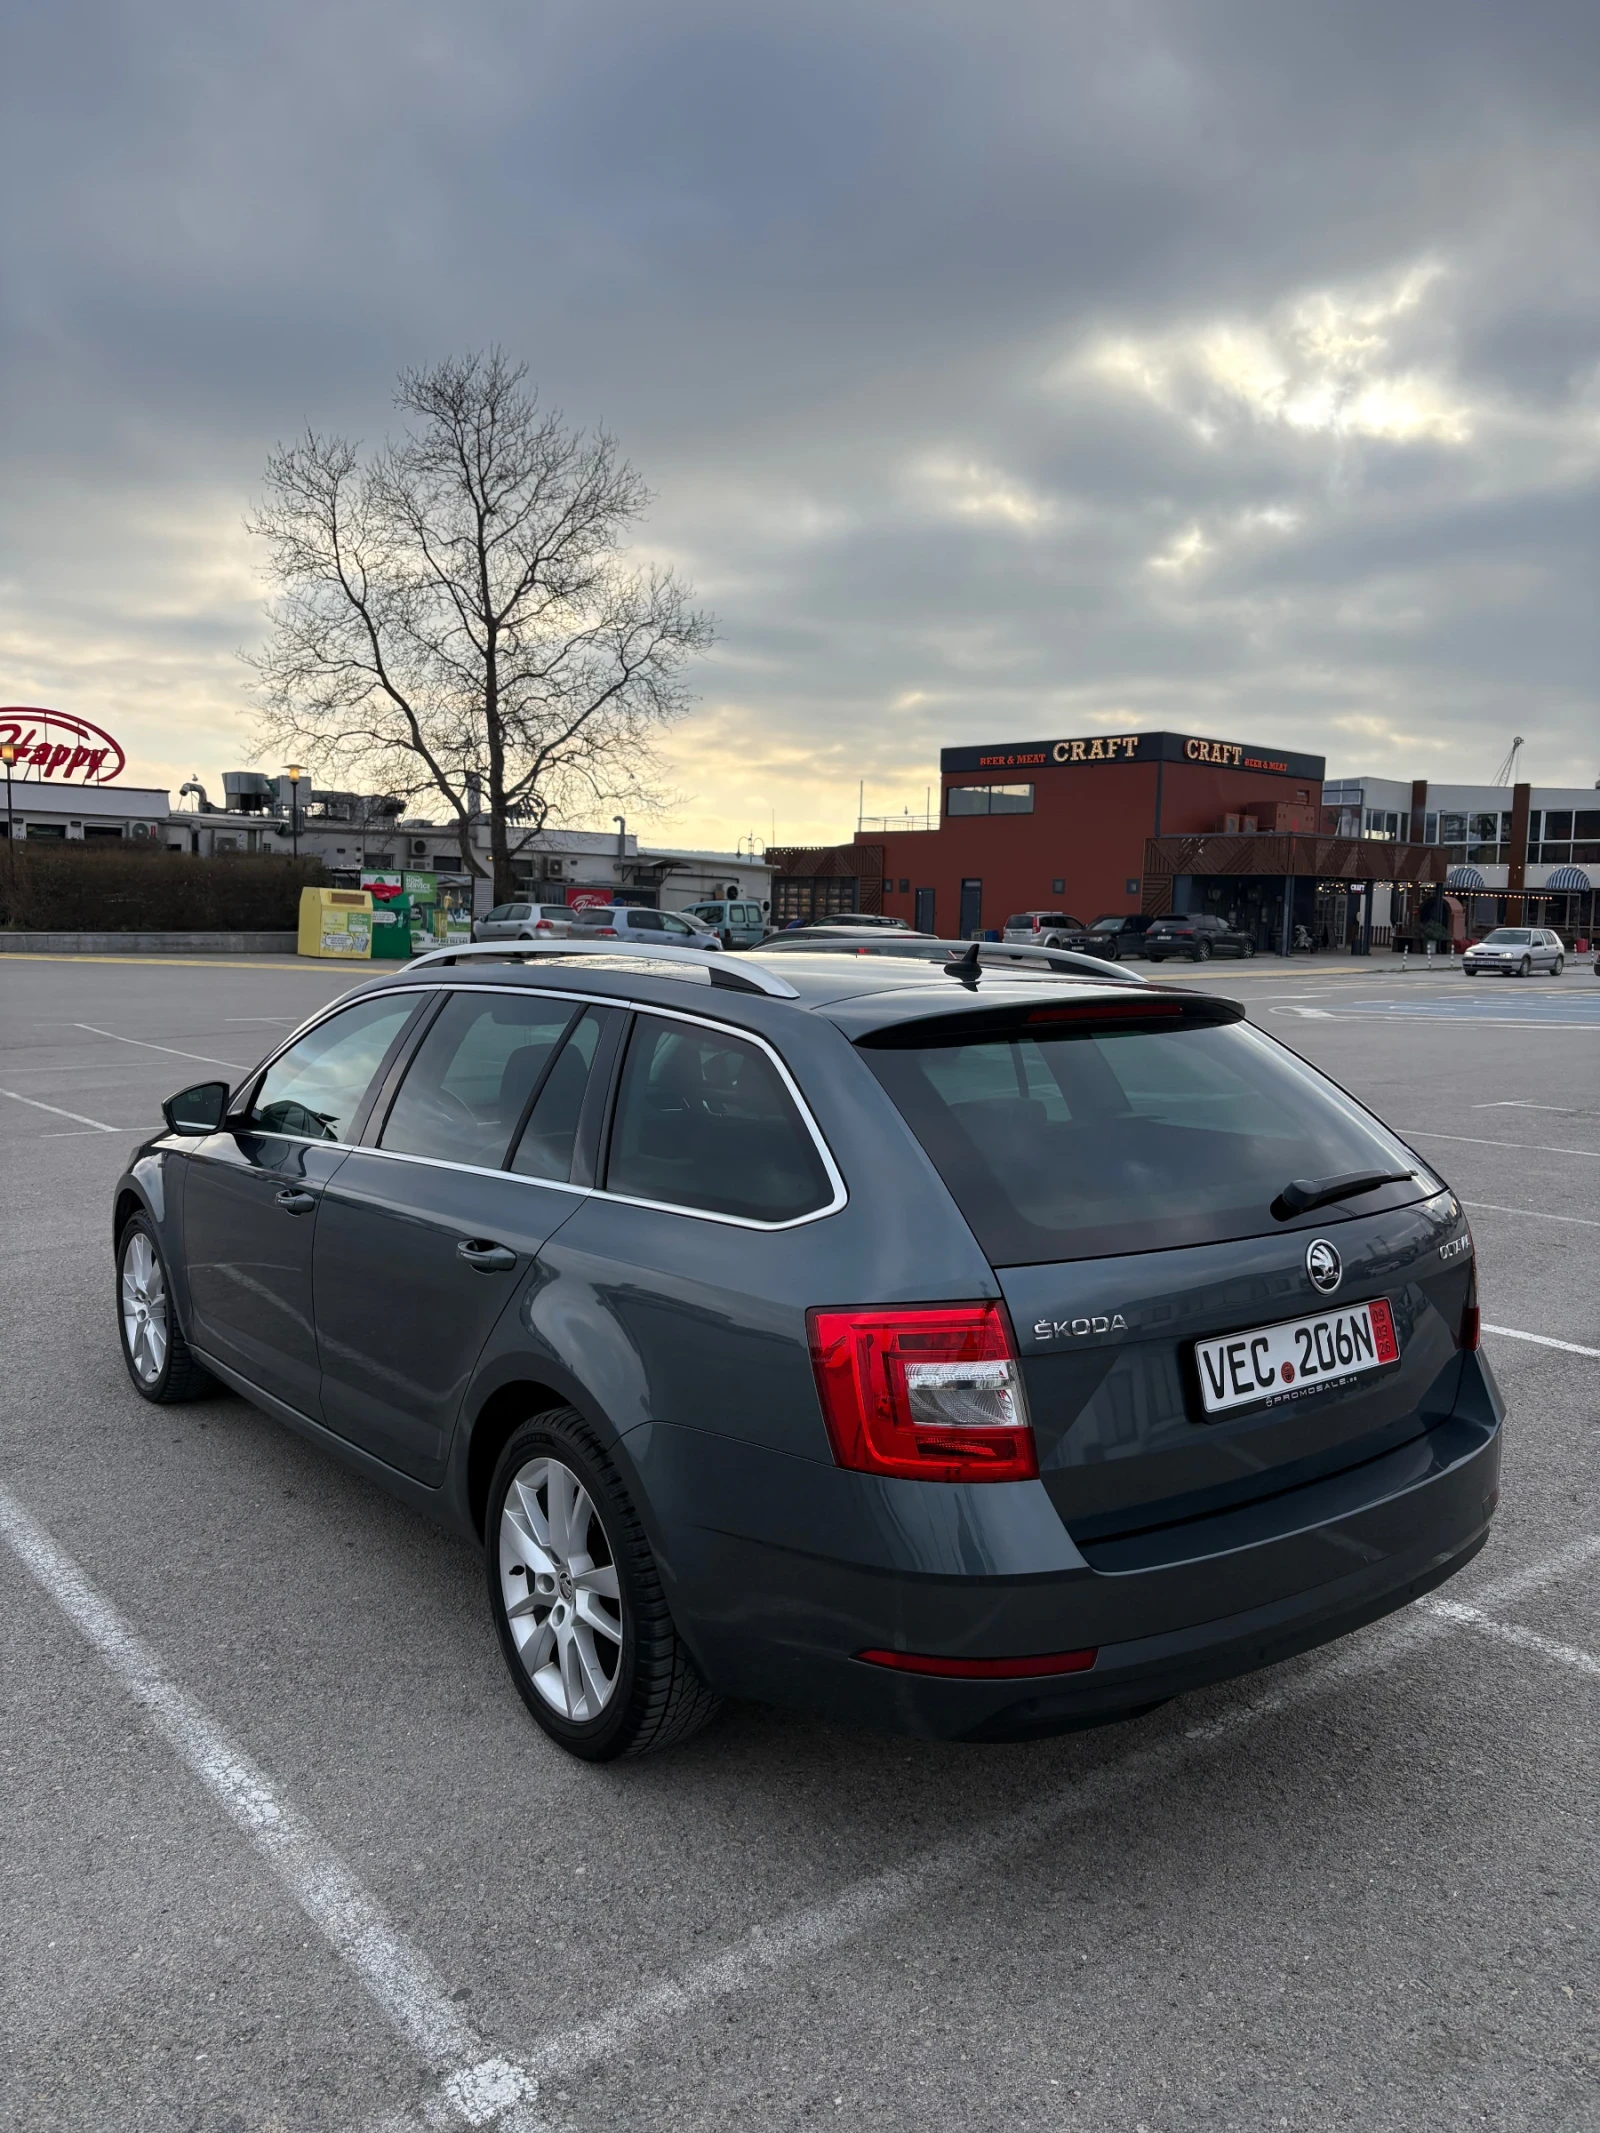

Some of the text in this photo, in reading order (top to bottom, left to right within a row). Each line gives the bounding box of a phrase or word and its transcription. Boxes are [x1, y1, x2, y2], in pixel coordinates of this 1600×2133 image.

[1052, 736, 1139, 763] CRAFT
[1185, 739, 1243, 765] CRAFT
[979, 753, 1047, 766] BEER & MEAT
[1244, 758, 1262, 769] BEER
[1268, 761, 1288, 772] MEAT
[1373, 1308, 1385, 1322] 09
[1034, 1314, 1129, 1341] ŠKODA
[1376, 1325, 1388, 1338] 03
[1379, 1340, 1391, 1355] 26
[1203, 1312, 1374, 1399] VEC 206N
